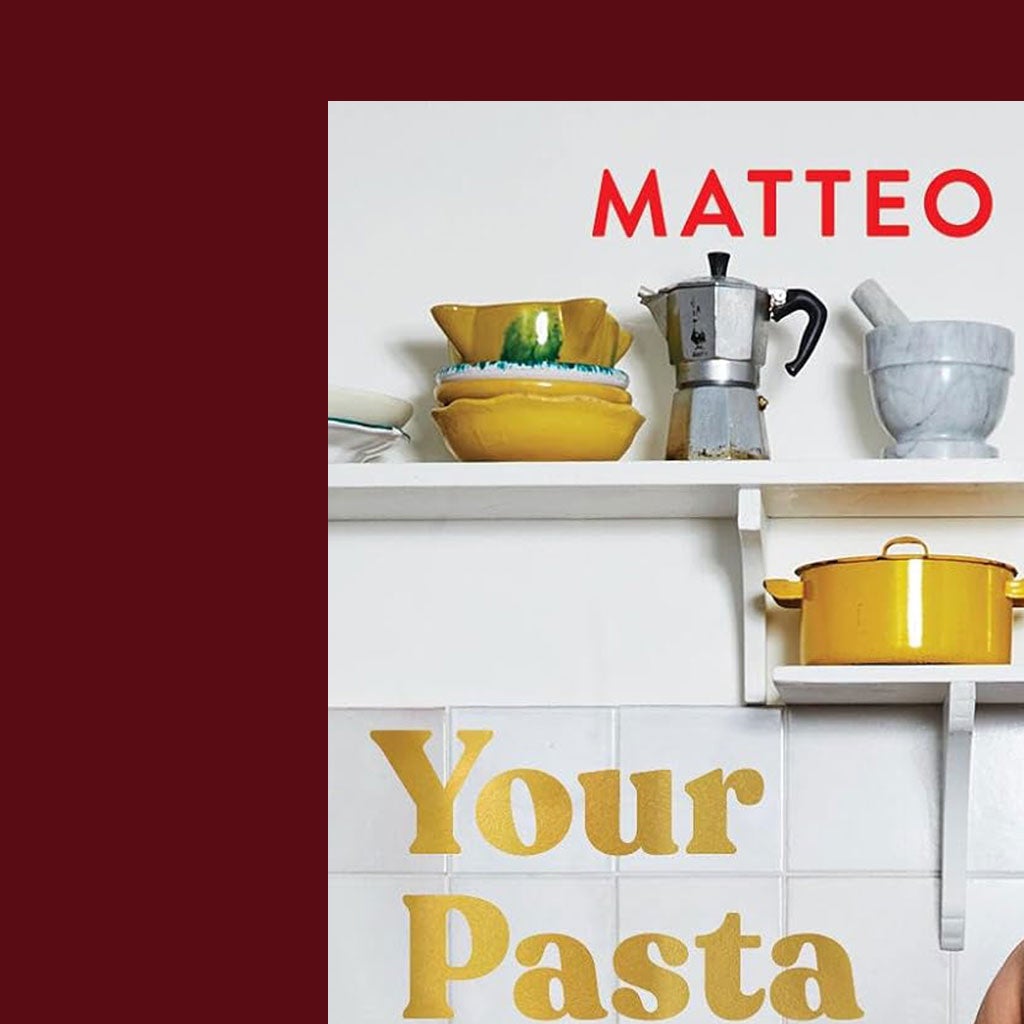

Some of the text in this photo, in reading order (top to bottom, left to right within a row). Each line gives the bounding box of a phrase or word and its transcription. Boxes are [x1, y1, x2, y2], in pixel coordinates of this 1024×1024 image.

[592, 168, 994, 239] MATTEO
[369, 729, 765, 857] Your
[402, 894, 865, 1022] Pasta
